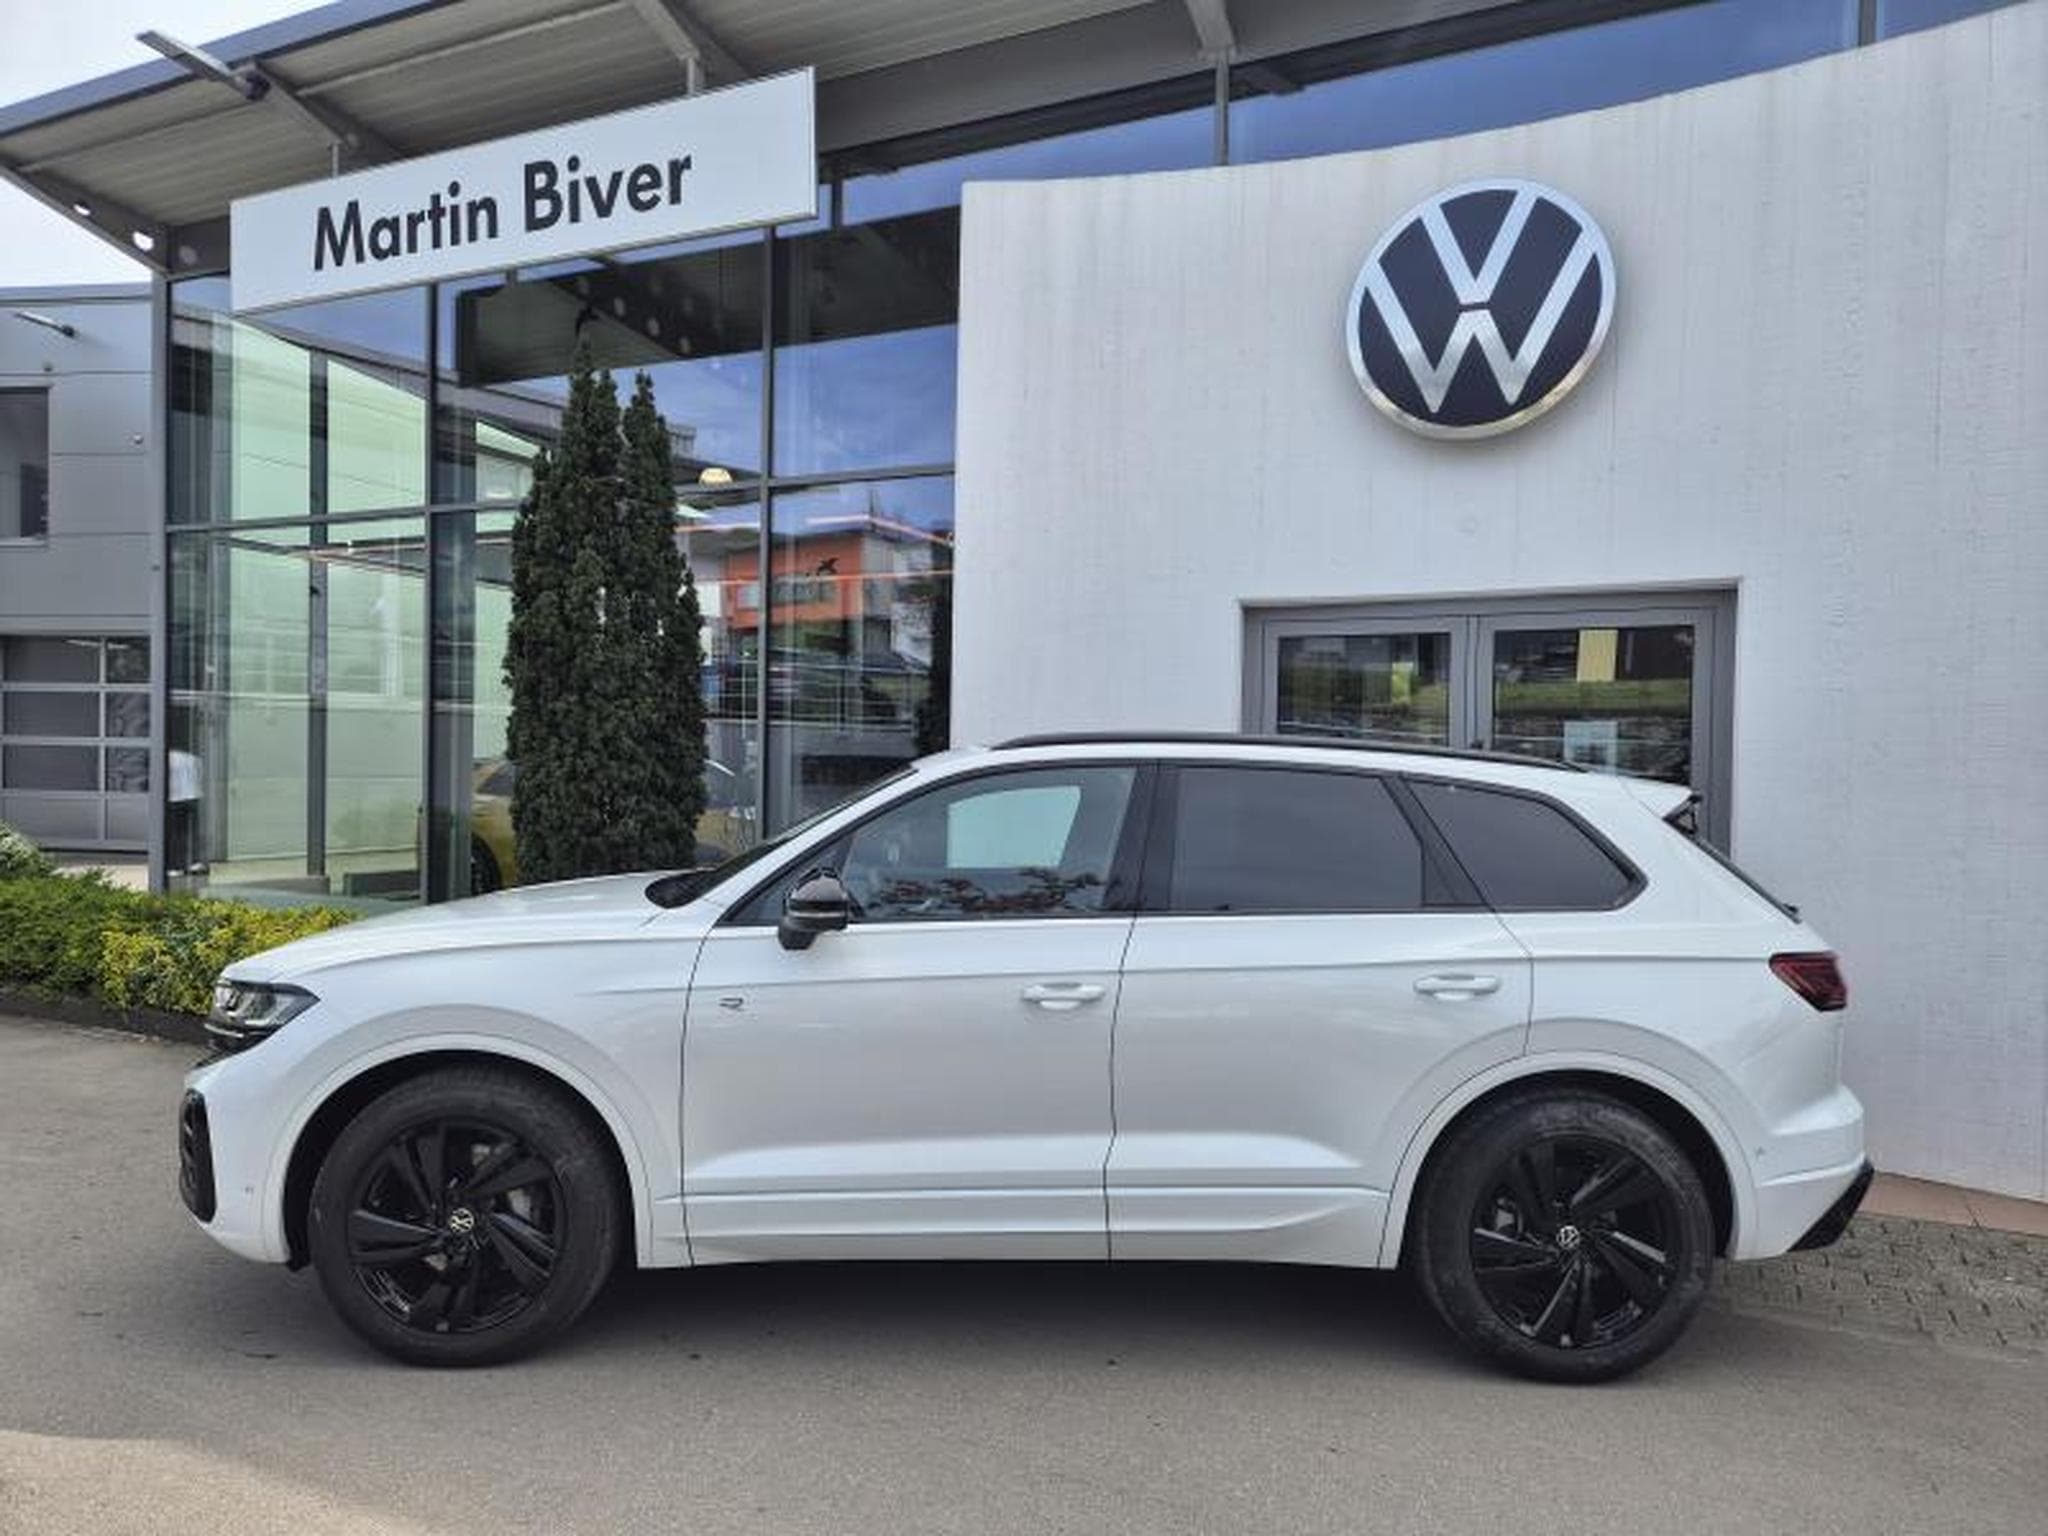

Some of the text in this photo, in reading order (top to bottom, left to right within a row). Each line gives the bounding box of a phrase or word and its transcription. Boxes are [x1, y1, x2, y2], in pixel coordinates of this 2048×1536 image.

[313, 154, 693, 272] Martin Biver
[1353, 181, 1605, 416] VW
